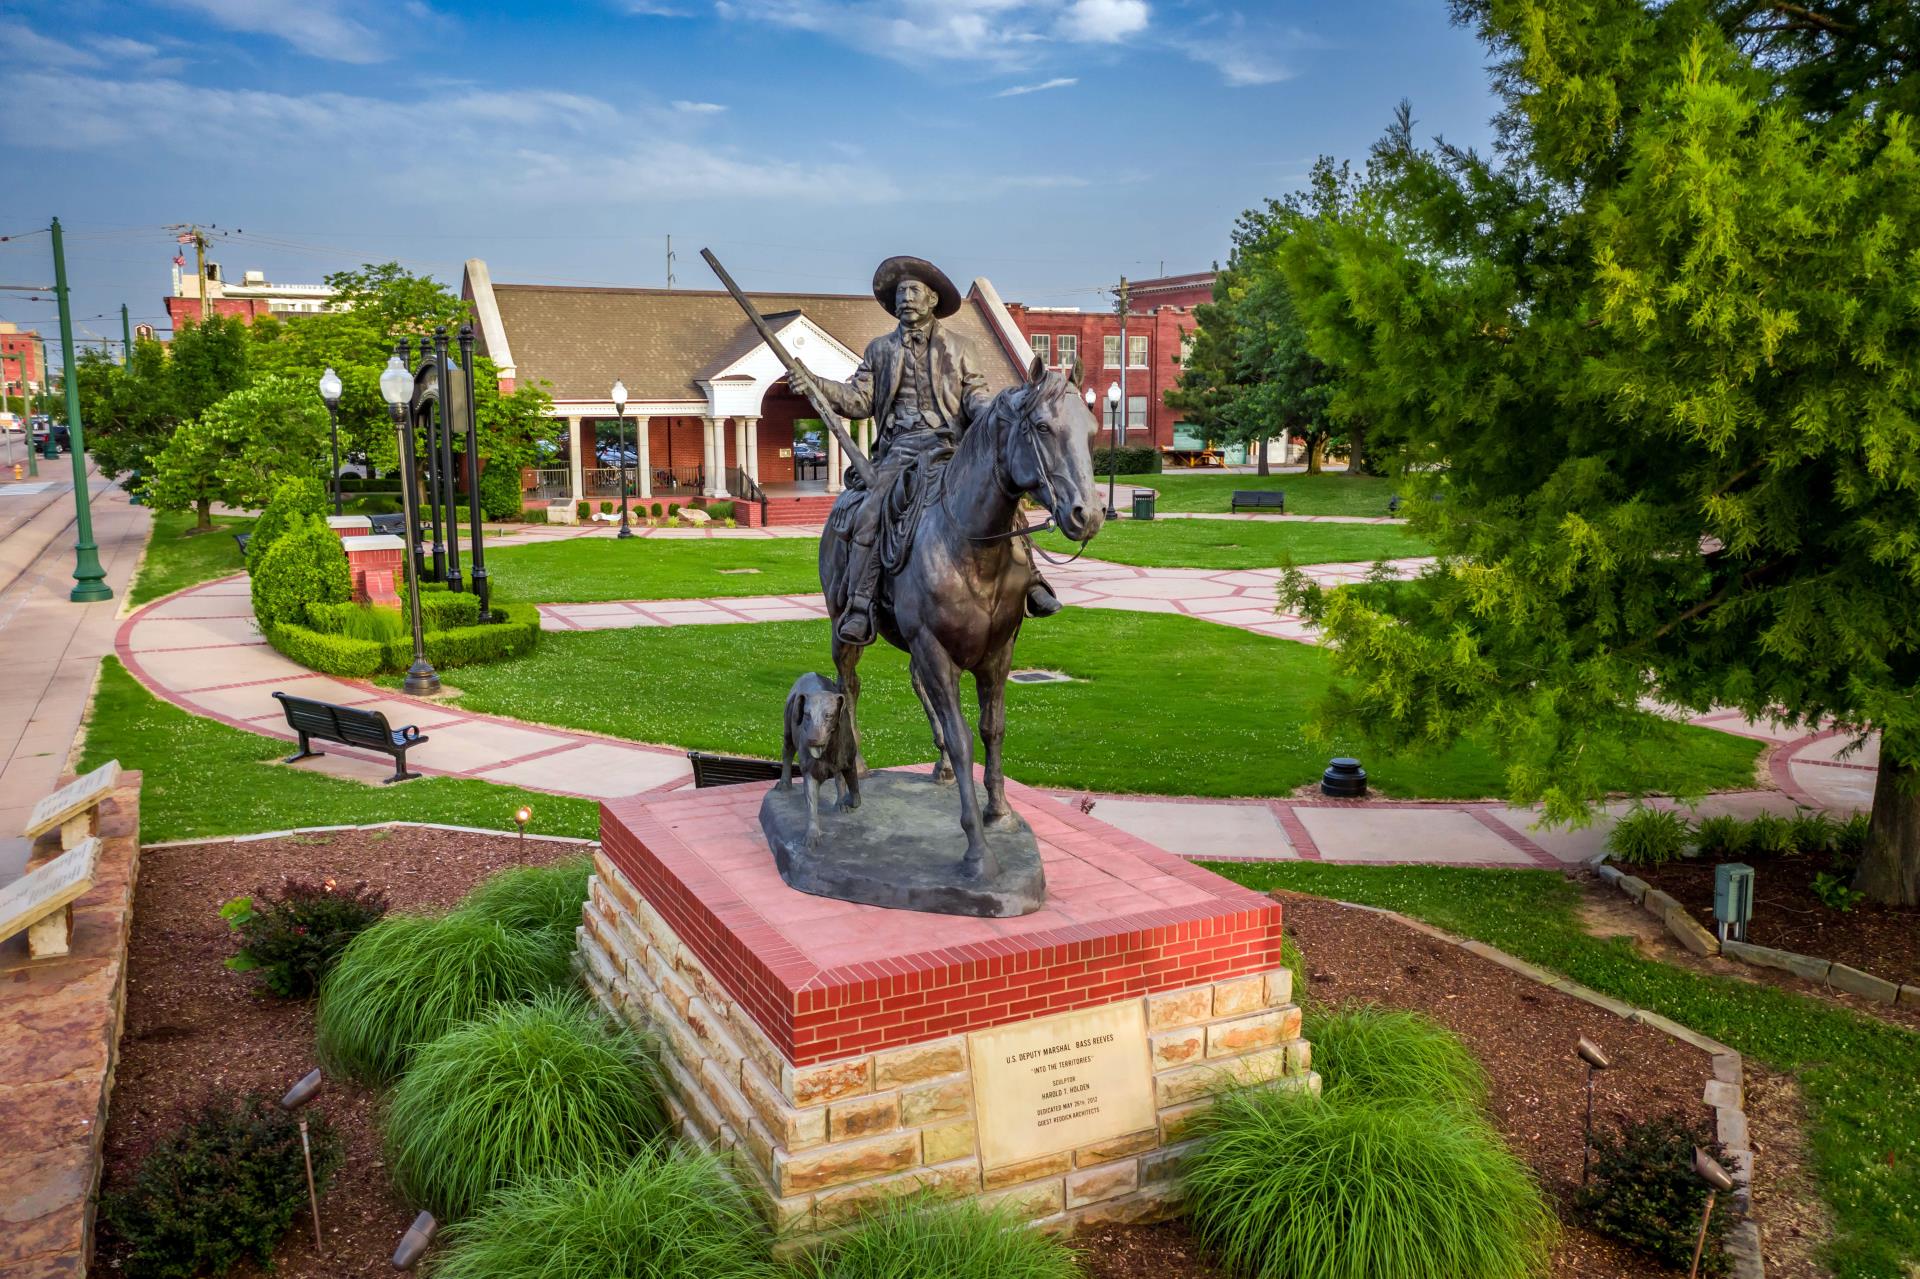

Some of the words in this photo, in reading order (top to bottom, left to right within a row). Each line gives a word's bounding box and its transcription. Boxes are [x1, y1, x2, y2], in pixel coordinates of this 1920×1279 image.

[1019, 1050, 1041, 1061] DEPUTY
[1043, 1043, 1071, 1055] MARSHAL
[1075, 1040, 1092, 1049] BASS
[1092, 1034, 1114, 1045] REEVES
[1047, 1063, 1057, 1071] THE
[1052, 1076, 1076, 1086] SCULPTOR
[1041, 1089, 1062, 1100] HAROLD
[1069, 1083, 1090, 1093] HOLDEN
[1037, 1105, 1062, 1116] DEDICATED
[1072, 1107, 1100, 1118] ARCHITECTS
